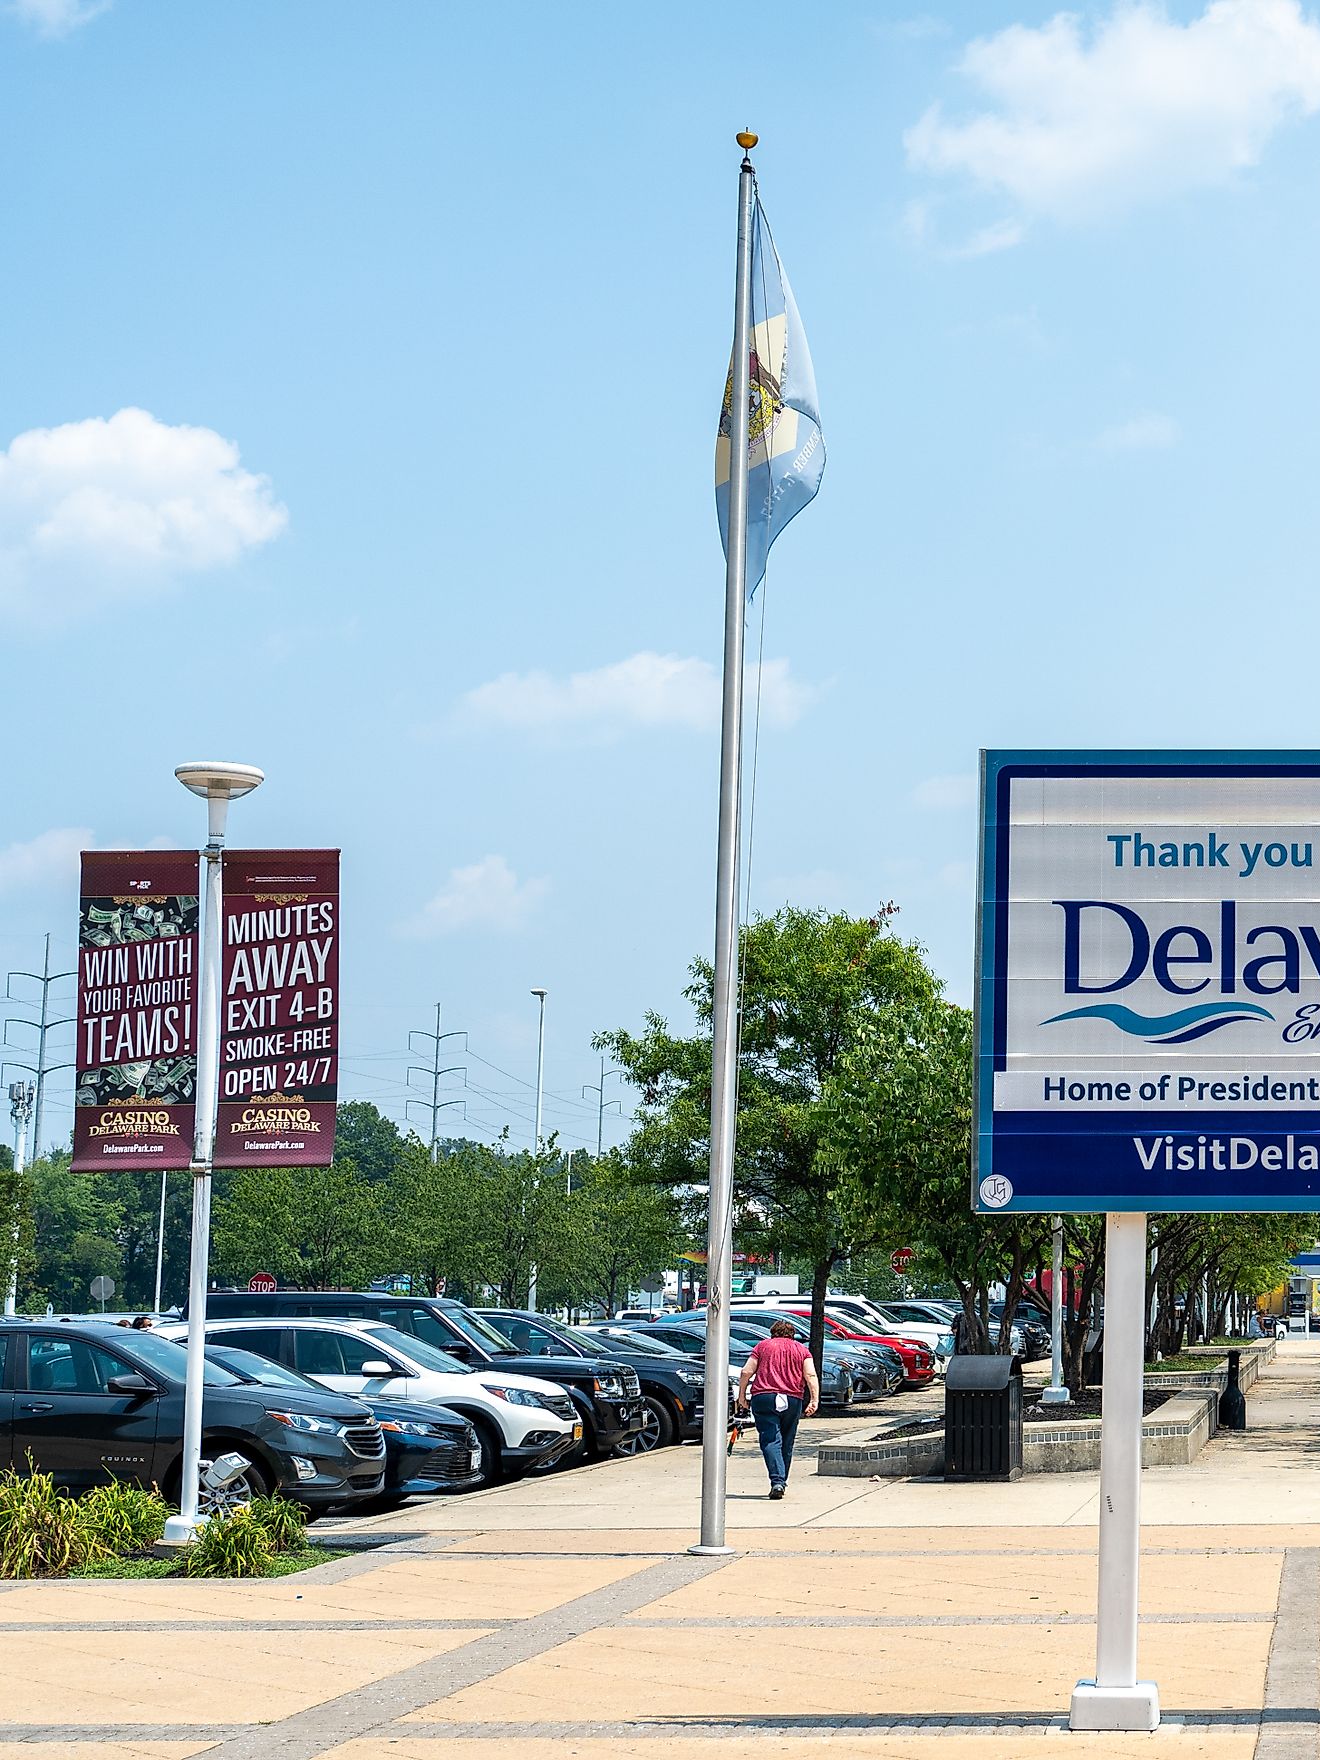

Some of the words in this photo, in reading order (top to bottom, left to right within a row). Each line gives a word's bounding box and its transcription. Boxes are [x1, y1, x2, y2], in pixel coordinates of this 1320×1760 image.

[1107, 833, 1229, 868] Thank
[1239, 841, 1313, 878] you
[227, 901, 334, 946] MINUTES
[84, 946, 129, 988] WIN
[136, 937, 193, 979] WITH
[227, 937, 333, 995] AWAY
[84, 988, 121, 1015] YOUR
[126, 977, 191, 1008] FAVORITE
[227, 993, 282, 1033] EXIT
[289, 987, 333, 1022] 4-B
[84, 1004, 191, 1065] TEAMS!
[225, 1027, 332, 1062] SMOKE-FREE
[225, 1063, 277, 1097] OPEN
[283, 1057, 332, 1089] 24/7
[1044, 1076, 1131, 1102] Home
[1137, 1075, 1170, 1102] of
[1177, 1076, 1320, 1102] President
[88, 1124, 148, 1136] DELAWARE
[150, 1124, 180, 1136] PARK
[100, 1110, 170, 1125] CASINO
[230, 1121, 290, 1134] DELAWARE
[291, 1121, 322, 1134] PARK
[241, 1108, 311, 1122] CASINO
[103, 1144, 164, 1154] DelawarePark.com
[244, 1140, 305, 1150] DelawarePark.com
[251, 1281, 274, 1292] STOP
